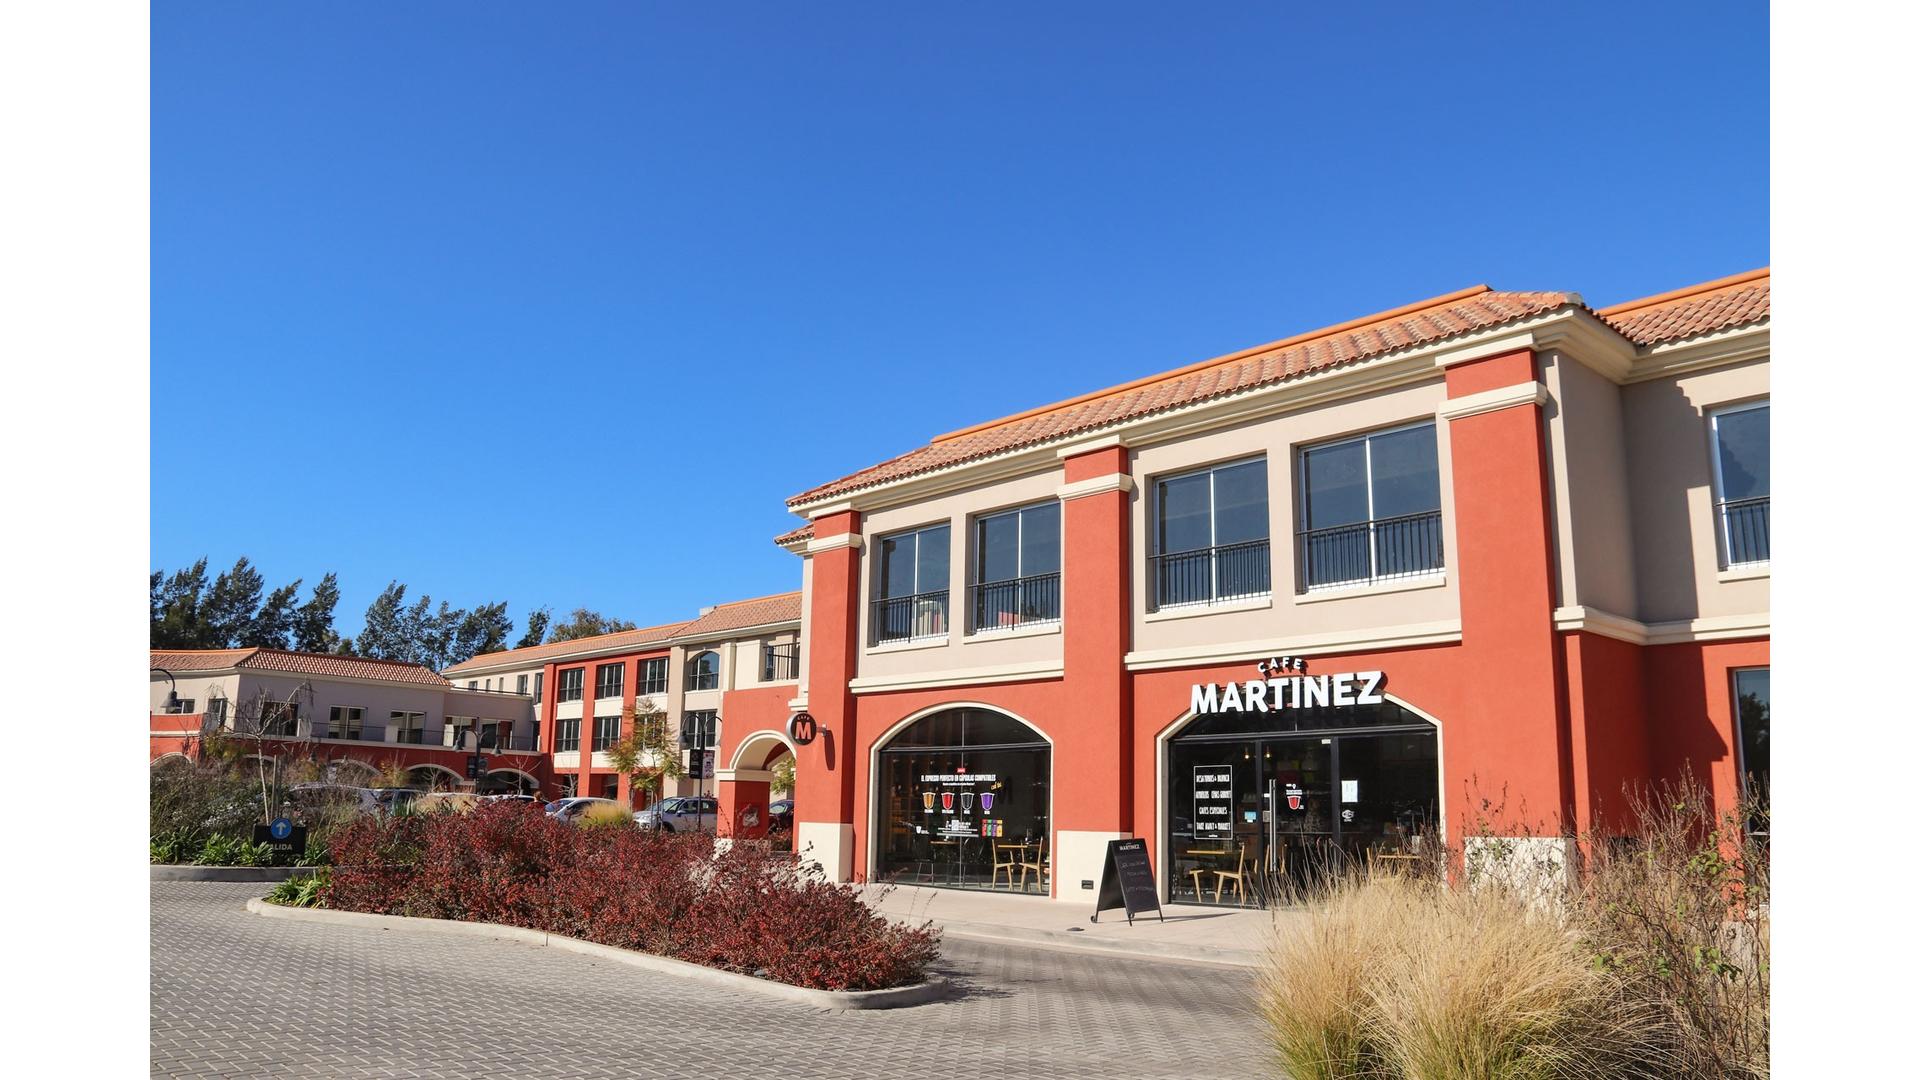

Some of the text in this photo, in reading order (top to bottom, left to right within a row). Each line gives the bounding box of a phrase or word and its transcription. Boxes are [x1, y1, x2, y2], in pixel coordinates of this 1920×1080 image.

[1257, 656, 1302, 672] CAFE
[1190, 671, 1383, 714] MARTINEZ
[795, 721, 812, 740] M
